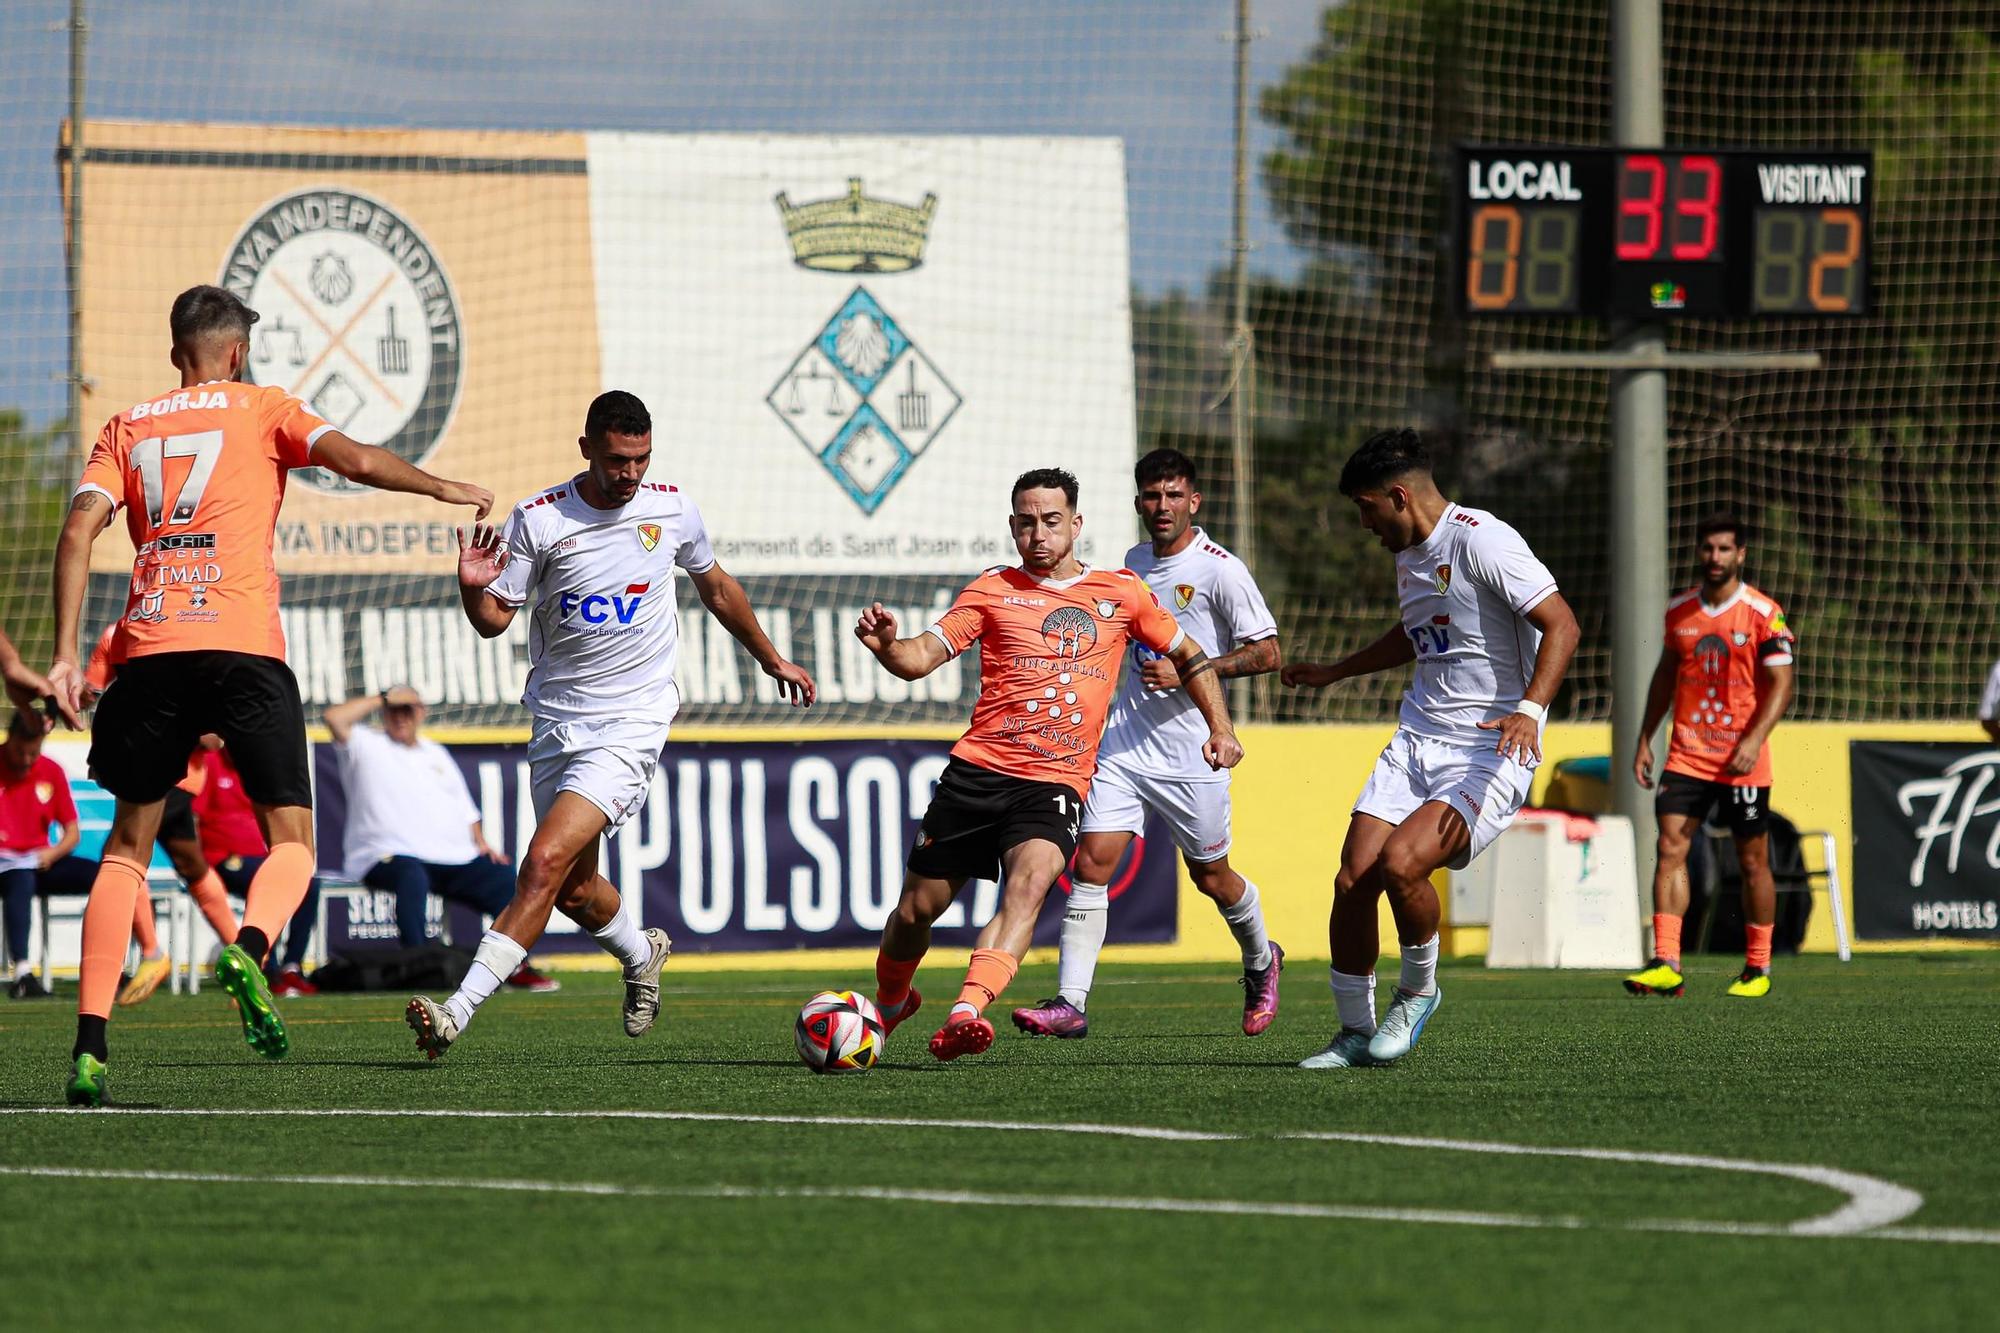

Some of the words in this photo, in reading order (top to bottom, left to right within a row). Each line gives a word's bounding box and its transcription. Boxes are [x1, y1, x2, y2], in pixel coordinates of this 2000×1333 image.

[1469, 160, 1583, 202] LOCAL
[1757, 163, 1867, 205] VISITANT
[1616, 155, 1722, 260] 33
[271, 196, 457, 353] INDEPENDENT
[130, 391, 228, 421] BORJA
[129, 429, 225, 529] 17
[804, 535, 836, 558] de
[845, 533, 899, 558] Sant
[905, 534, 960, 559] Joan
[971, 535, 998, 558] de
[559, 590, 642, 625] FCV
[1003, 596, 1047, 607] KELME
[1410, 626, 1451, 654] CV
[1002, 716, 1027, 732] SIX
[1912, 901, 1998, 930] HOTELS
